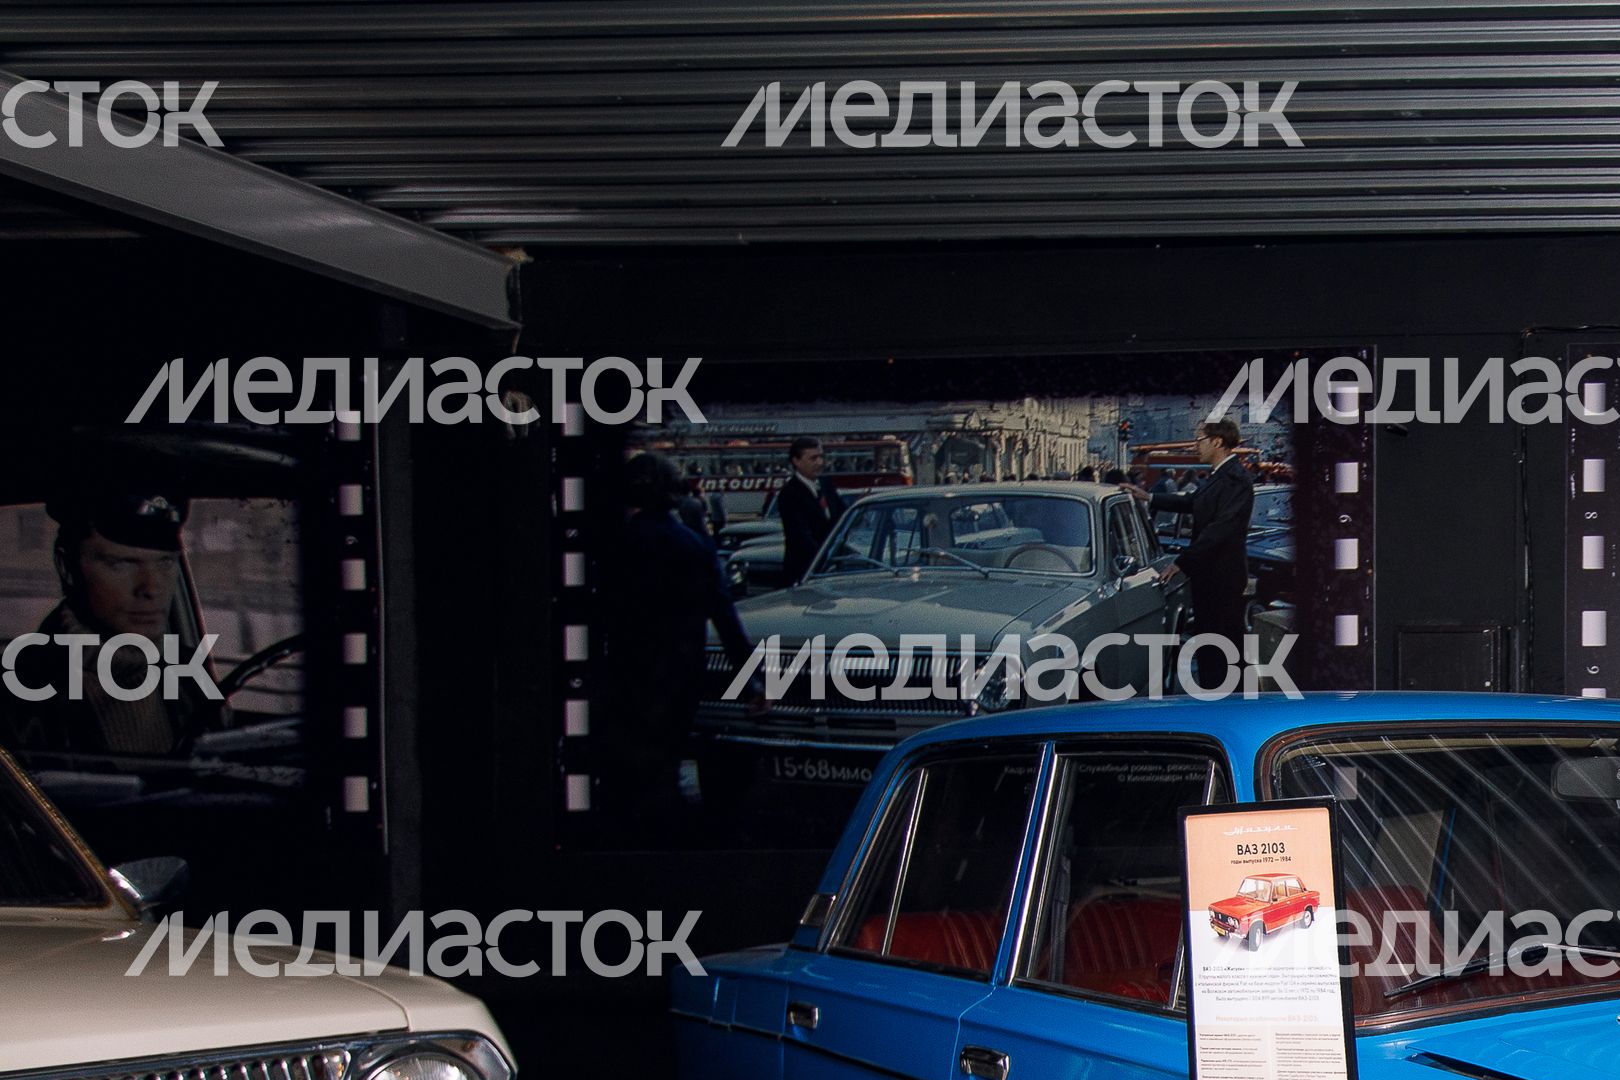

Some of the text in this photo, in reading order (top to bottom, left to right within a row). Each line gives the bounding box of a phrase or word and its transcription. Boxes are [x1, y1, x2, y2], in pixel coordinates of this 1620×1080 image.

[697, 476, 791, 490] Intouris
[1236, 842, 1286, 855] ВАЗ 2103
